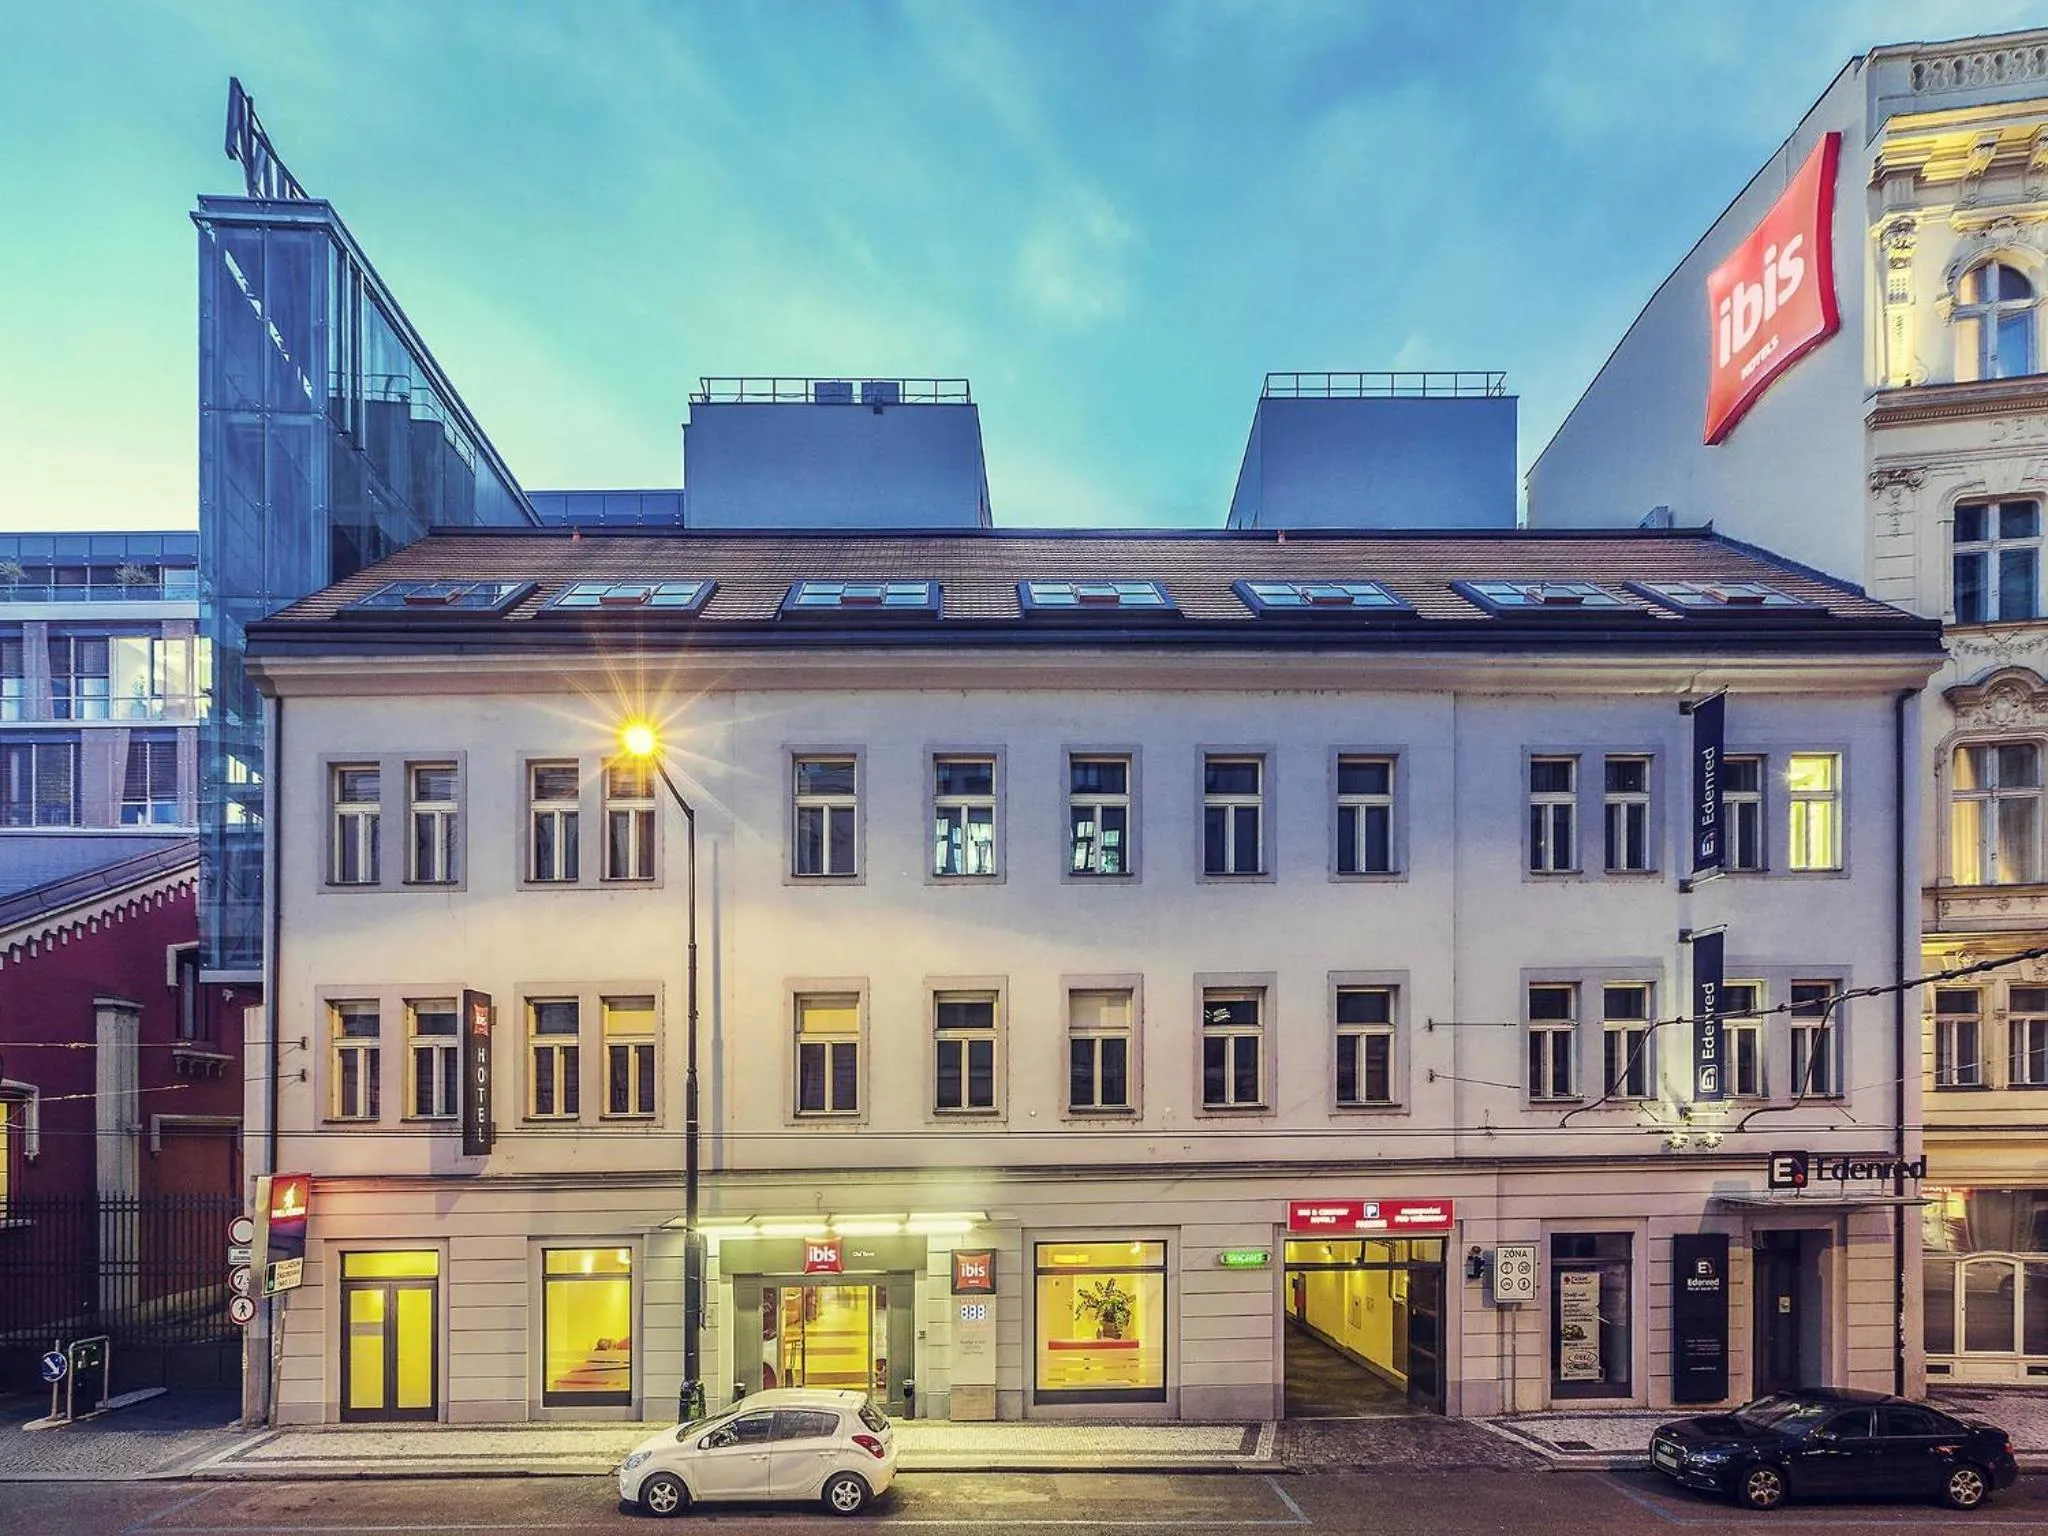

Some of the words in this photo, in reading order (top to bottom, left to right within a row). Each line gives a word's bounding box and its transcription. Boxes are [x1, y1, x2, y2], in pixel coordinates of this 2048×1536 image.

[1719, 233, 1805, 369] ibis
[1741, 334, 1780, 381] HOTELS
[1702, 745, 1715, 827] Edenred
[1702, 981, 1715, 1060] Edenred
[477, 1047, 486, 1143] HOTEL
[1816, 1154, 1927, 1181] Edenred
[809, 1246, 837, 1262] ibis
[961, 1263, 985, 1277] ibis
